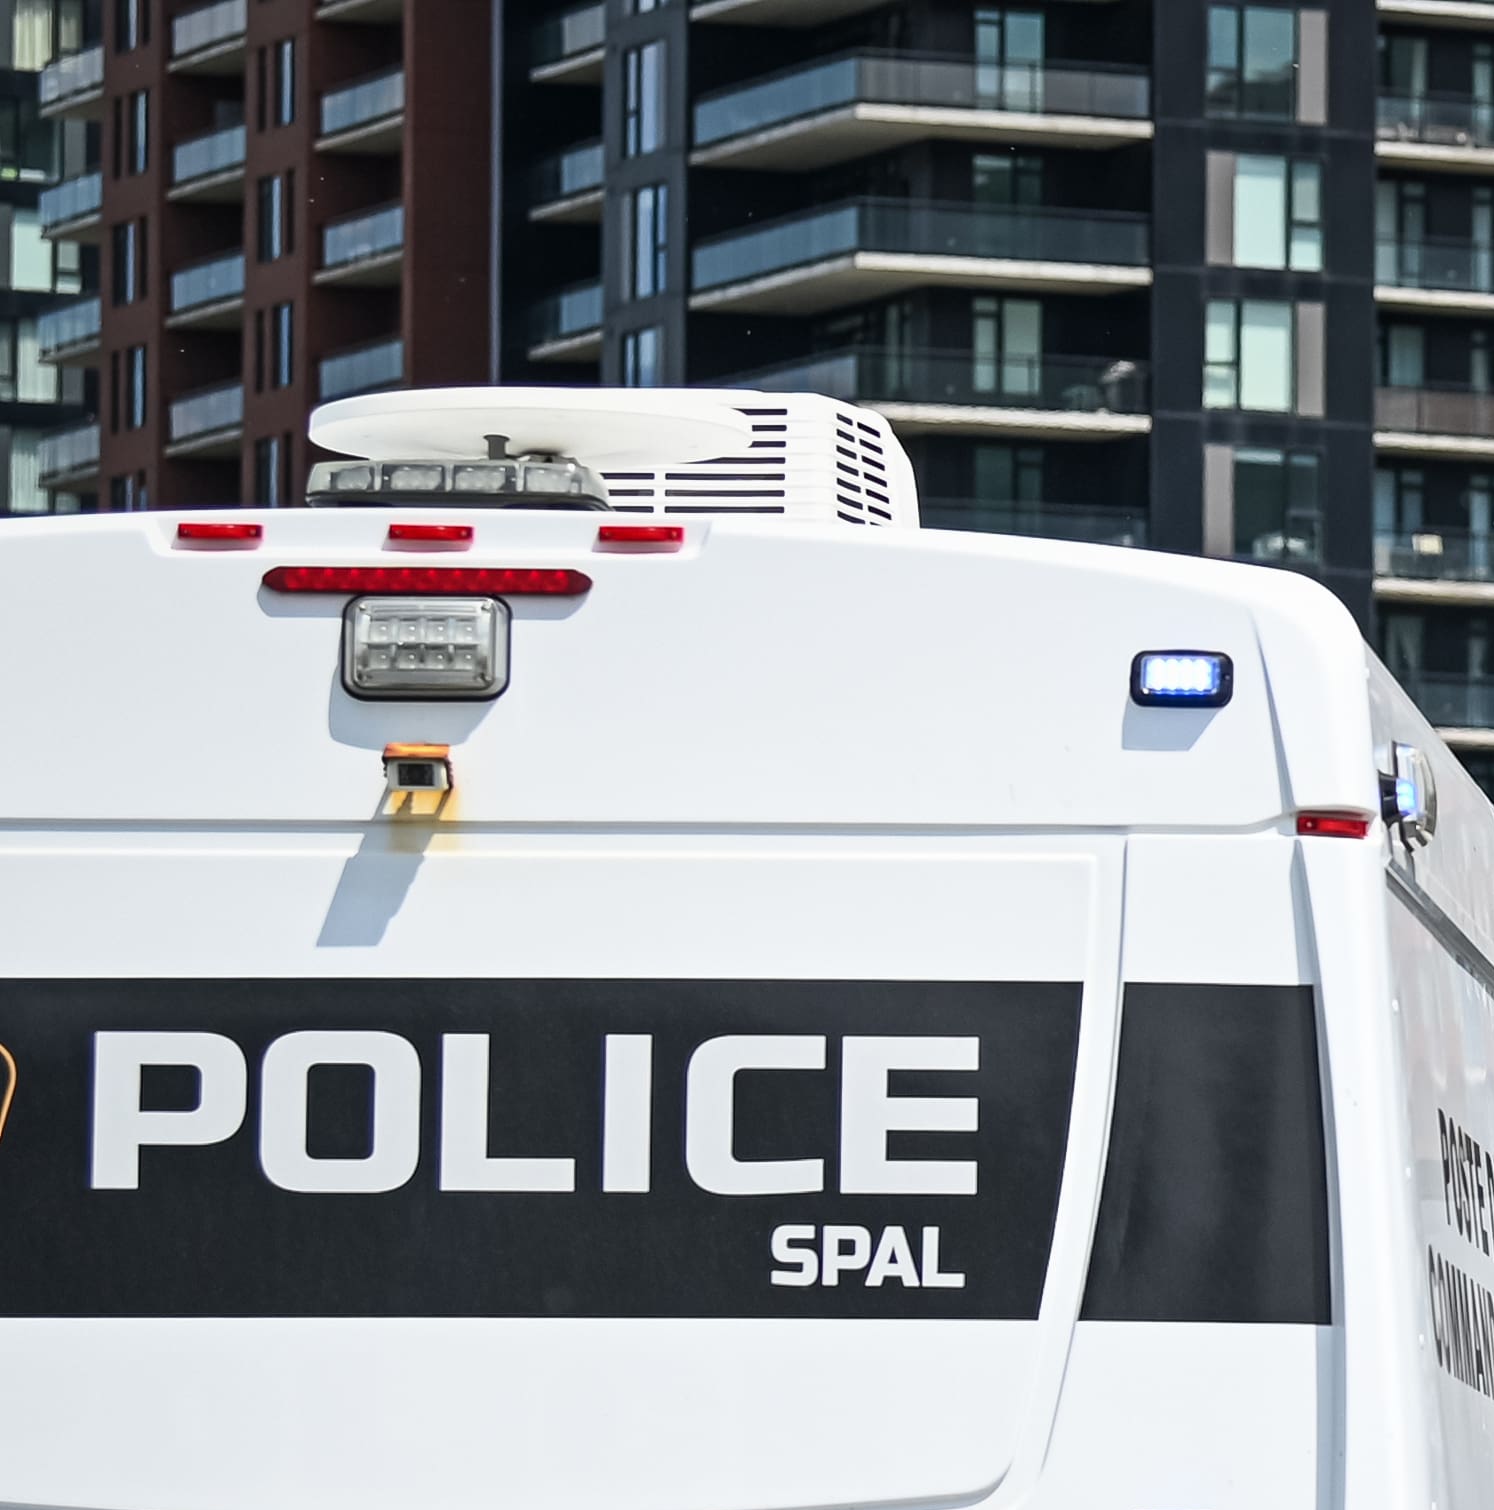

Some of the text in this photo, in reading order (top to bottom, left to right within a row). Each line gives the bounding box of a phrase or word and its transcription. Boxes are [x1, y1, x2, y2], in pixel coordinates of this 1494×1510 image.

[91, 1030, 980, 1196] POLICE
[1437, 1107, 1490, 1258] POSTE
[770, 1224, 966, 1288] SPAL
